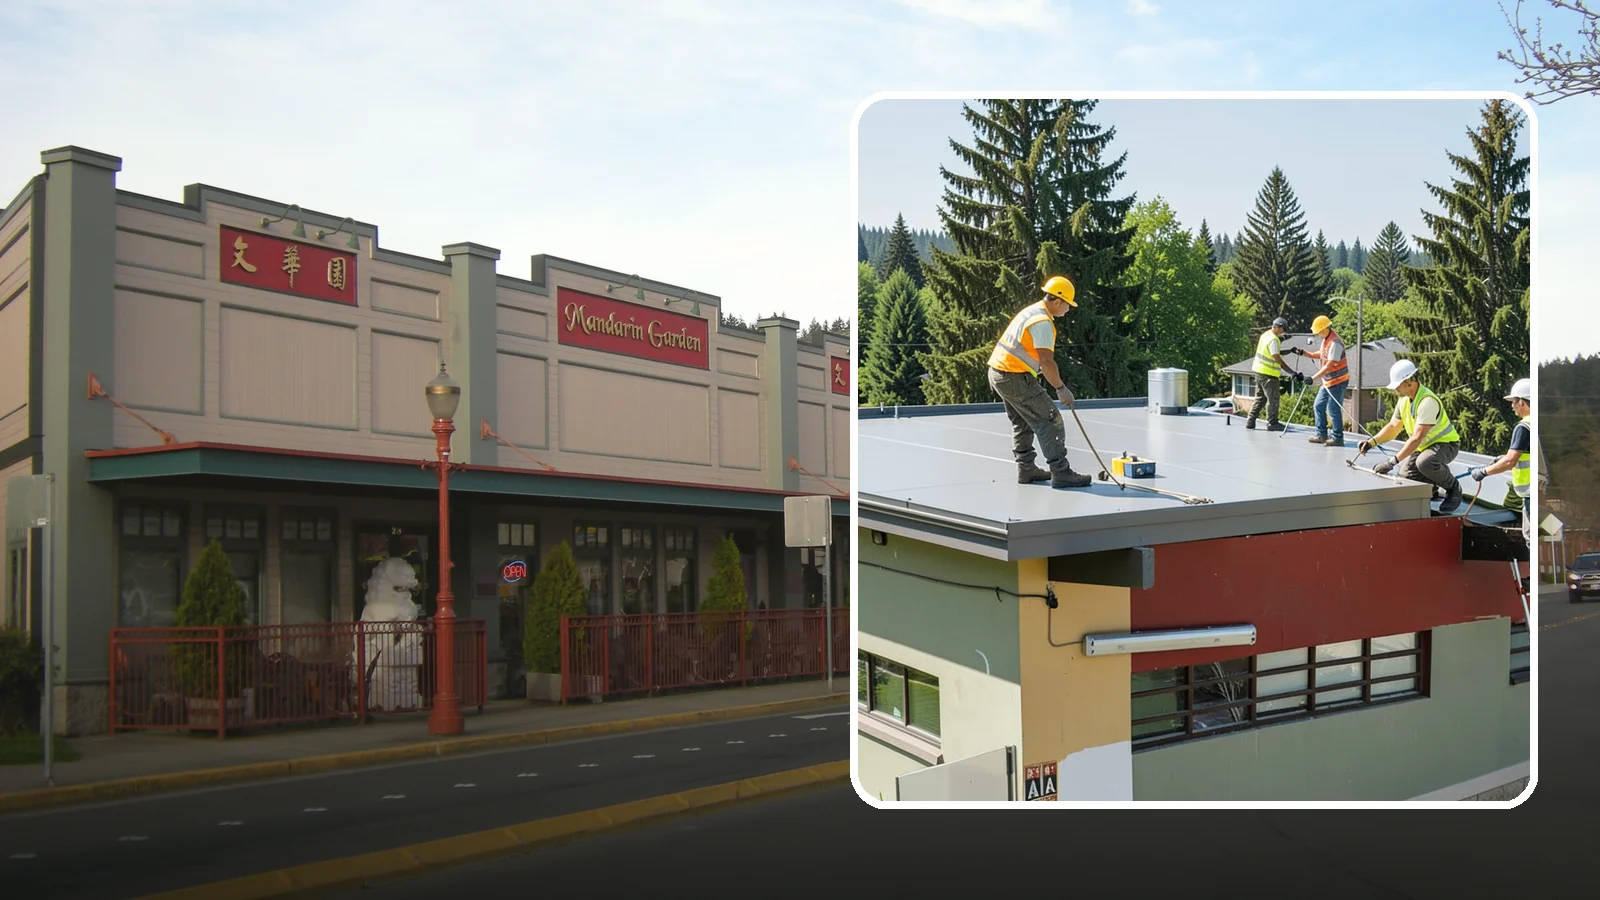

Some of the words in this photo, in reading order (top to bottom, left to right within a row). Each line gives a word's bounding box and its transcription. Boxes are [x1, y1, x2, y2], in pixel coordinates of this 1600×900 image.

[231, 236, 346, 291] 文華園
[564, 302, 644, 341] Mandarin
[648, 320, 701, 352] Garden
[503, 565, 527, 578] OPEN
